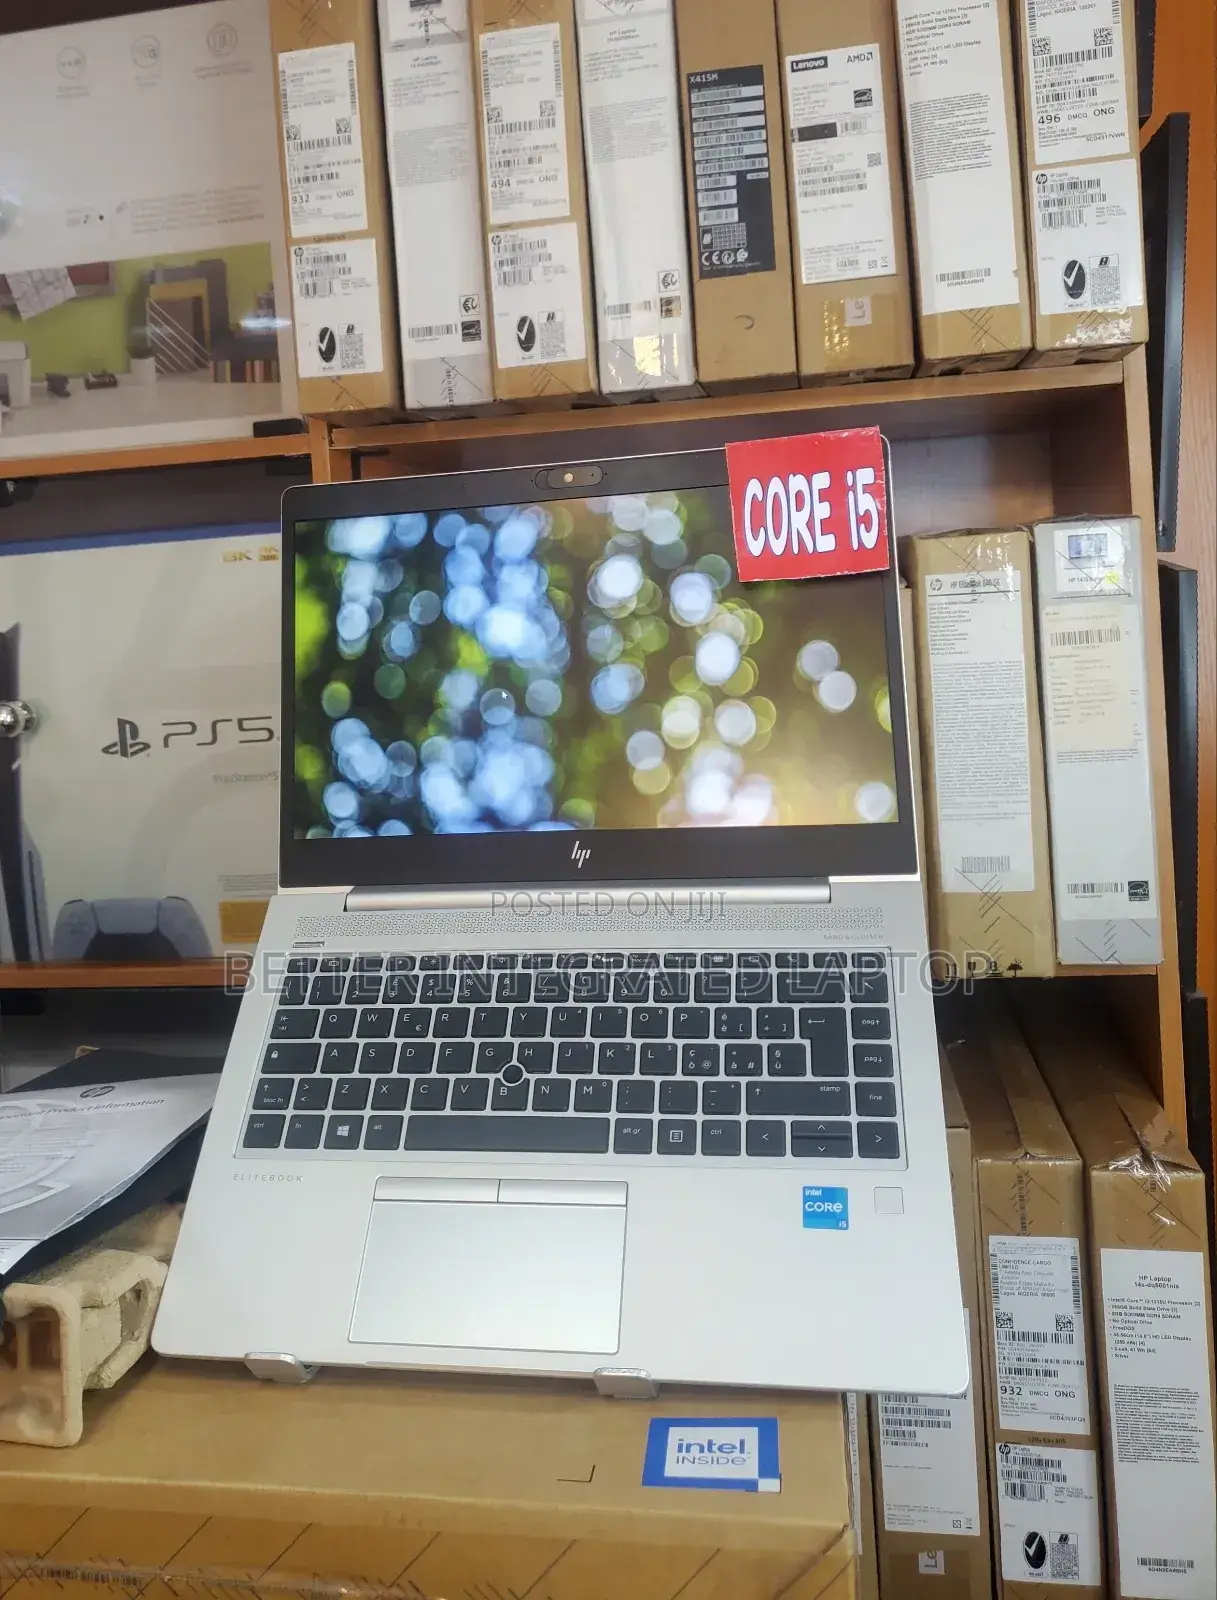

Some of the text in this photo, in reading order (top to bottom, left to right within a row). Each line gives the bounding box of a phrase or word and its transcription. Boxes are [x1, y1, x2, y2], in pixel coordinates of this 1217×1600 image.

[847, 53, 866, 64] AMD
[793, 59, 825, 70] Lenovo
[689, 73, 719, 83] X415M
[1038, 114, 1061, 125] 496
[1093, 107, 1115, 117] ONG
[491, 178, 511, 188] 494
[292, 194, 311, 204] 932
[744, 468, 879, 557] CORE i5
[161, 716, 275, 748] PS5
[571, 840, 592, 869] hp
[426, 990, 433, 998] 4
[329, 1015, 338, 1023] Q
[367, 1014, 379, 1022] W
[404, 1014, 411, 1022] E
[441, 1014, 449, 1022] R
[480, 1013, 487, 1021] T
[520, 1013, 528, 1021] Y
[559, 1013, 567, 1021] U
[640, 1013, 649, 1022] O
[331, 1049, 338, 1057] A
[369, 1049, 376, 1057] S
[407, 1049, 415, 1057] D
[446, 1049, 452, 1057] F
[486, 1048, 494, 1057] G
[525, 1048, 533, 1056] H
[565, 1049, 572, 1057] J
[607, 1049, 615, 1058] K
[648, 1050, 655, 1058] L
[748, 1061, 755, 1069] #
[341, 1085, 349, 1094] Z
[380, 1085, 389, 1094] X
[420, 1085, 429, 1094] C
[461, 1085, 470, 1094] V
[500, 1087, 508, 1096] B
[541, 1086, 550, 1094] N
[583, 1086, 593, 1095] M
[48, 1106, 91, 1114] Product
[92, 1099, 165, 1112] Information
[233, 1173, 303, 1182] ELITEBOOK
[805, 1188, 822, 1196] intel
[839, 1220, 847, 1228] i5
[1000, 1386, 1023, 1396] 932
[1054, 1391, 1076, 1399] ONG
[677, 1438, 745, 1454] intel
[676, 1456, 747, 1465] INSIDE
